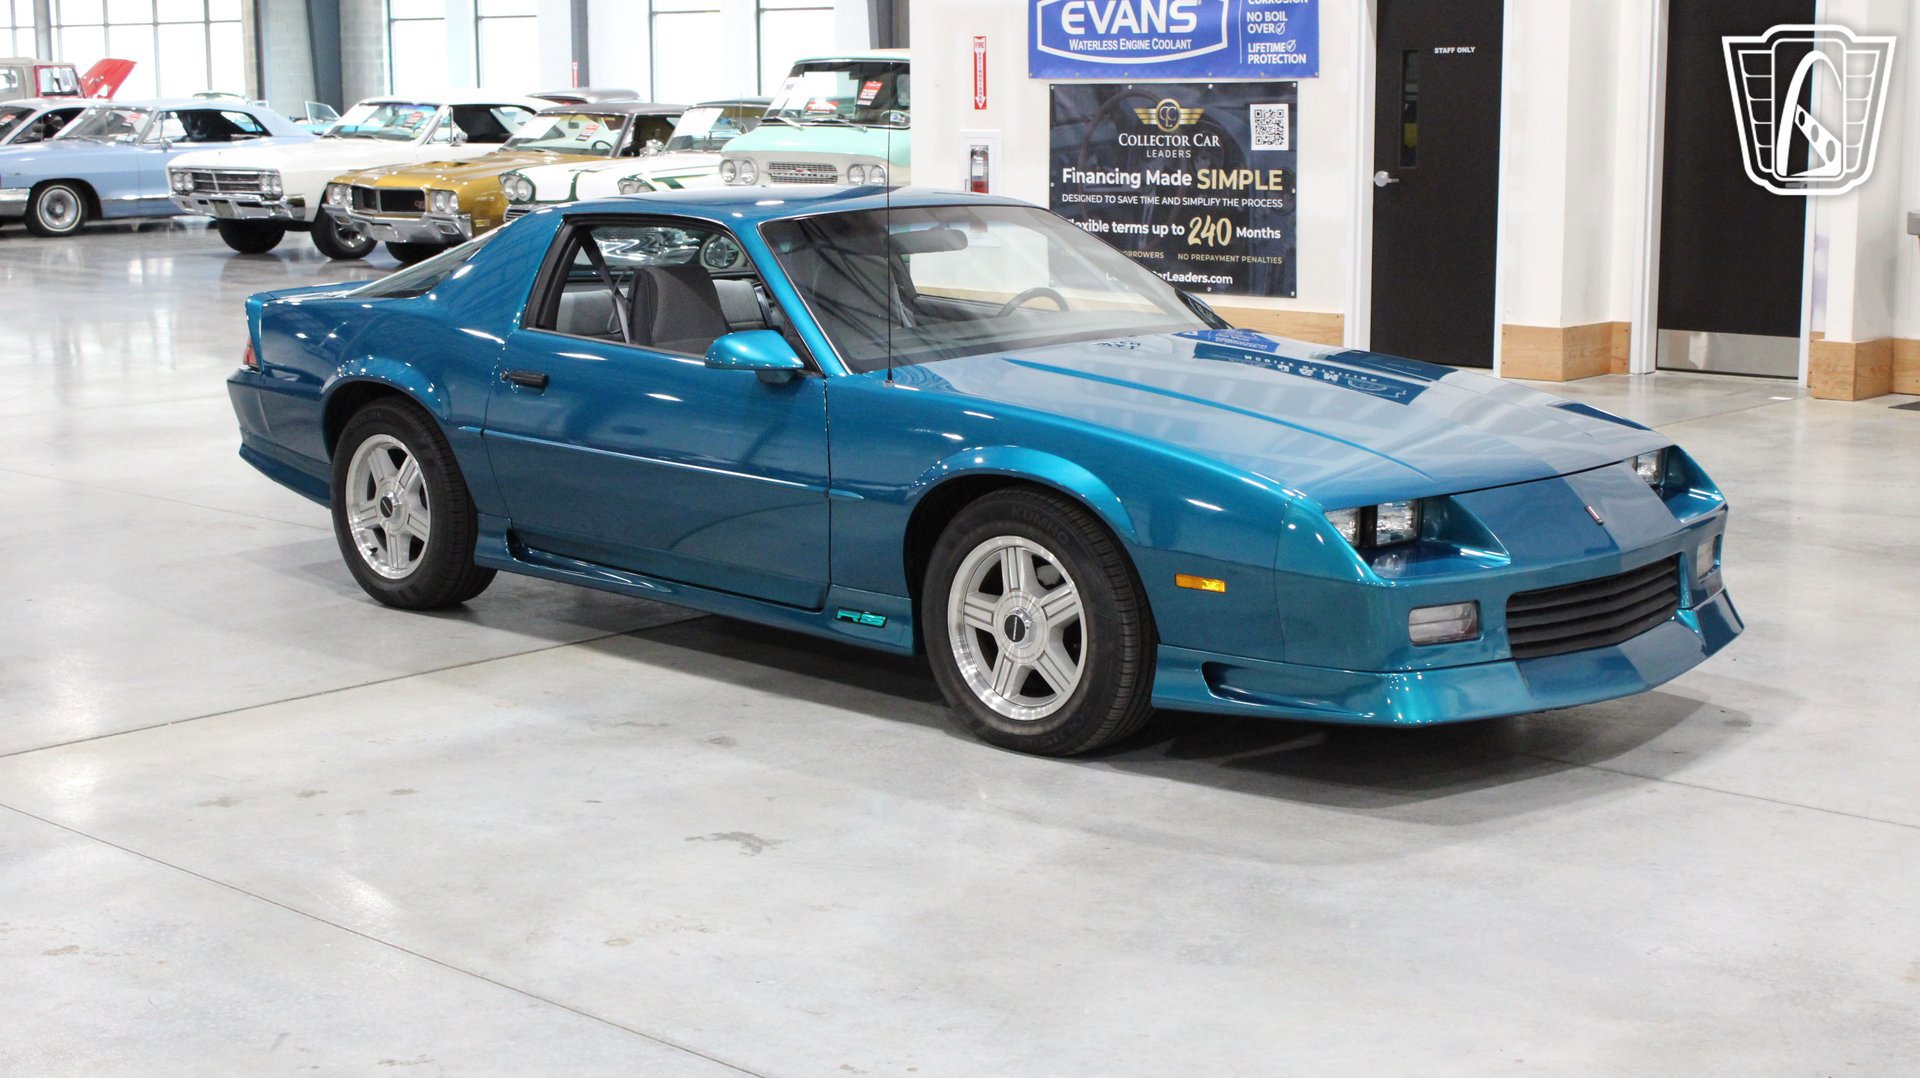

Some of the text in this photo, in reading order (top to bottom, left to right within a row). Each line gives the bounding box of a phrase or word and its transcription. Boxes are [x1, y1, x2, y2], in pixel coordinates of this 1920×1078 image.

[1061, 0, 1198, 34] EVANS
[1246, 11, 1288, 22] NO BOIL
[1248, 23, 1276, 34] OVER
[1069, 38, 1192, 50] WATERLESS ENGINE COOLANT
[1248, 42, 1286, 53] LIFETIME
[1248, 54, 1307, 64] PROTECTION
[1146, 150, 1192, 158] LEADERS
[1062, 167, 1283, 190] Financing Made SIMPLE
[1062, 194, 1283, 208] DESIGNED TO SAVE TIME AND SIMPLIFY THE PROCESS
[1068, 214, 1281, 247] xible terms up to 240 Months
[1121, 250, 1164, 259] ORROWERS
[1191, 254, 1239, 262] PREPAYMENT
[1242, 256, 1282, 264] PENALTIES
